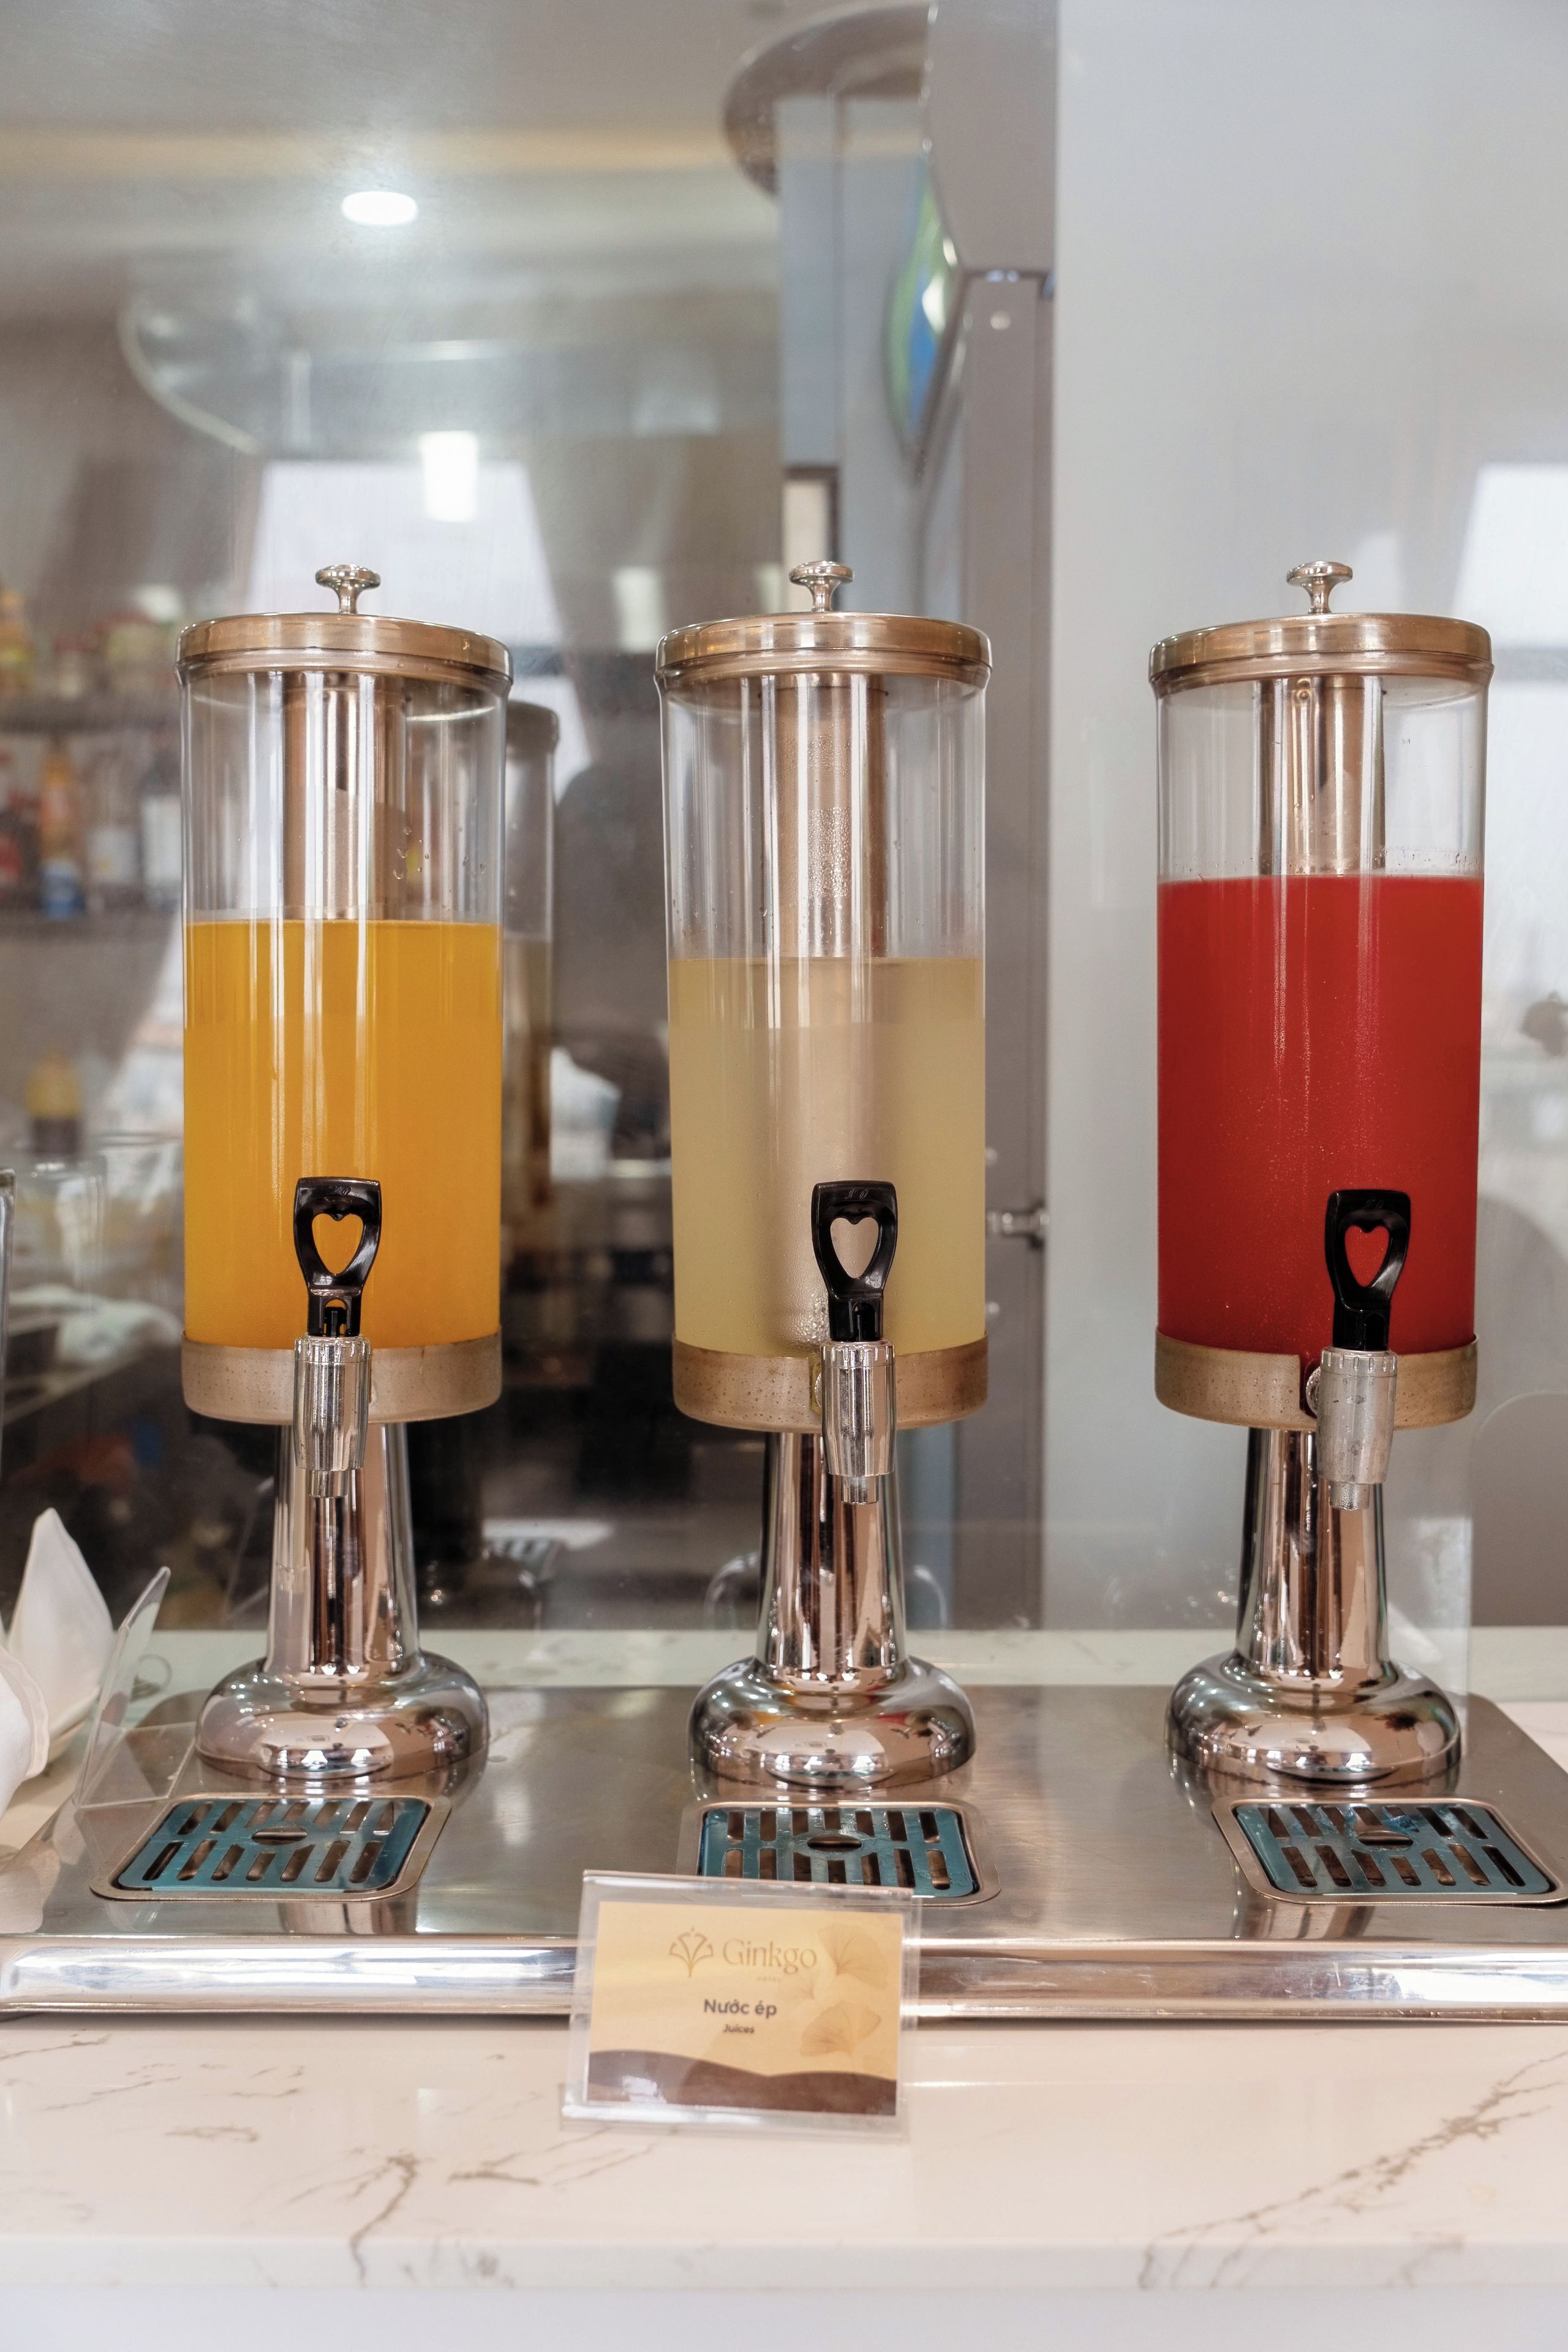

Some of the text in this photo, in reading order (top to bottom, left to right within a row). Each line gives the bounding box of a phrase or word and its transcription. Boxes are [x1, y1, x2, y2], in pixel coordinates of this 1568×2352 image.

[722, 1938, 817, 1975] Ginkgo
[704, 1999, 777, 2019] Nước ép
[723, 2024, 755, 2034] Juices
